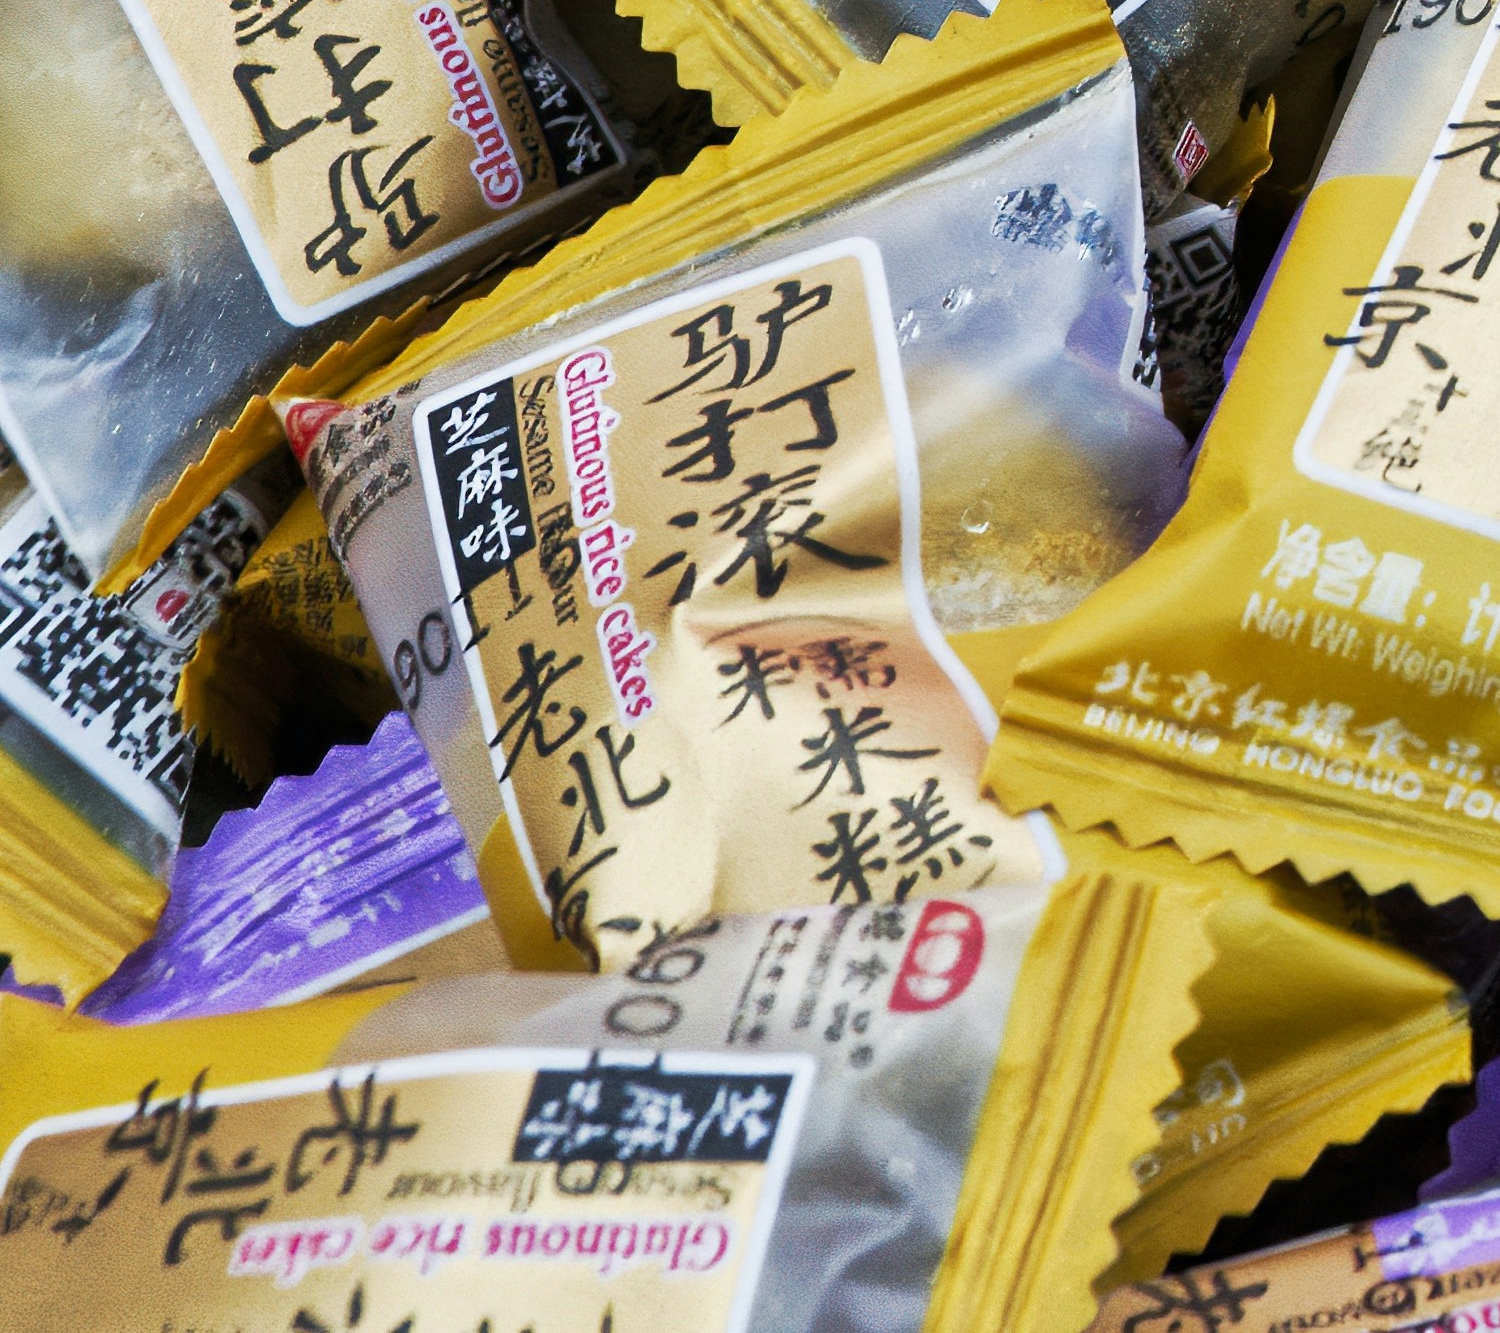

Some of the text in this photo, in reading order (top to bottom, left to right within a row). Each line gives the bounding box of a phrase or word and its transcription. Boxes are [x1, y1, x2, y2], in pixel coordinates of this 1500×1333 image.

[419, 7, 522, 205] Glutinous
[439, 392, 527, 563] 芝麻味
[644, 280, 891, 606] 驴打滚
[564, 353, 652, 720] Glutinous rice cakes
[1239, 590, 1310, 643] Net
[1081, 703, 1219, 754] BEIJING
[1242, 740, 1423, 802] HONGLUO
[369, 1221, 462, 1273] rice
[484, 1219, 732, 1273] Glutinous
